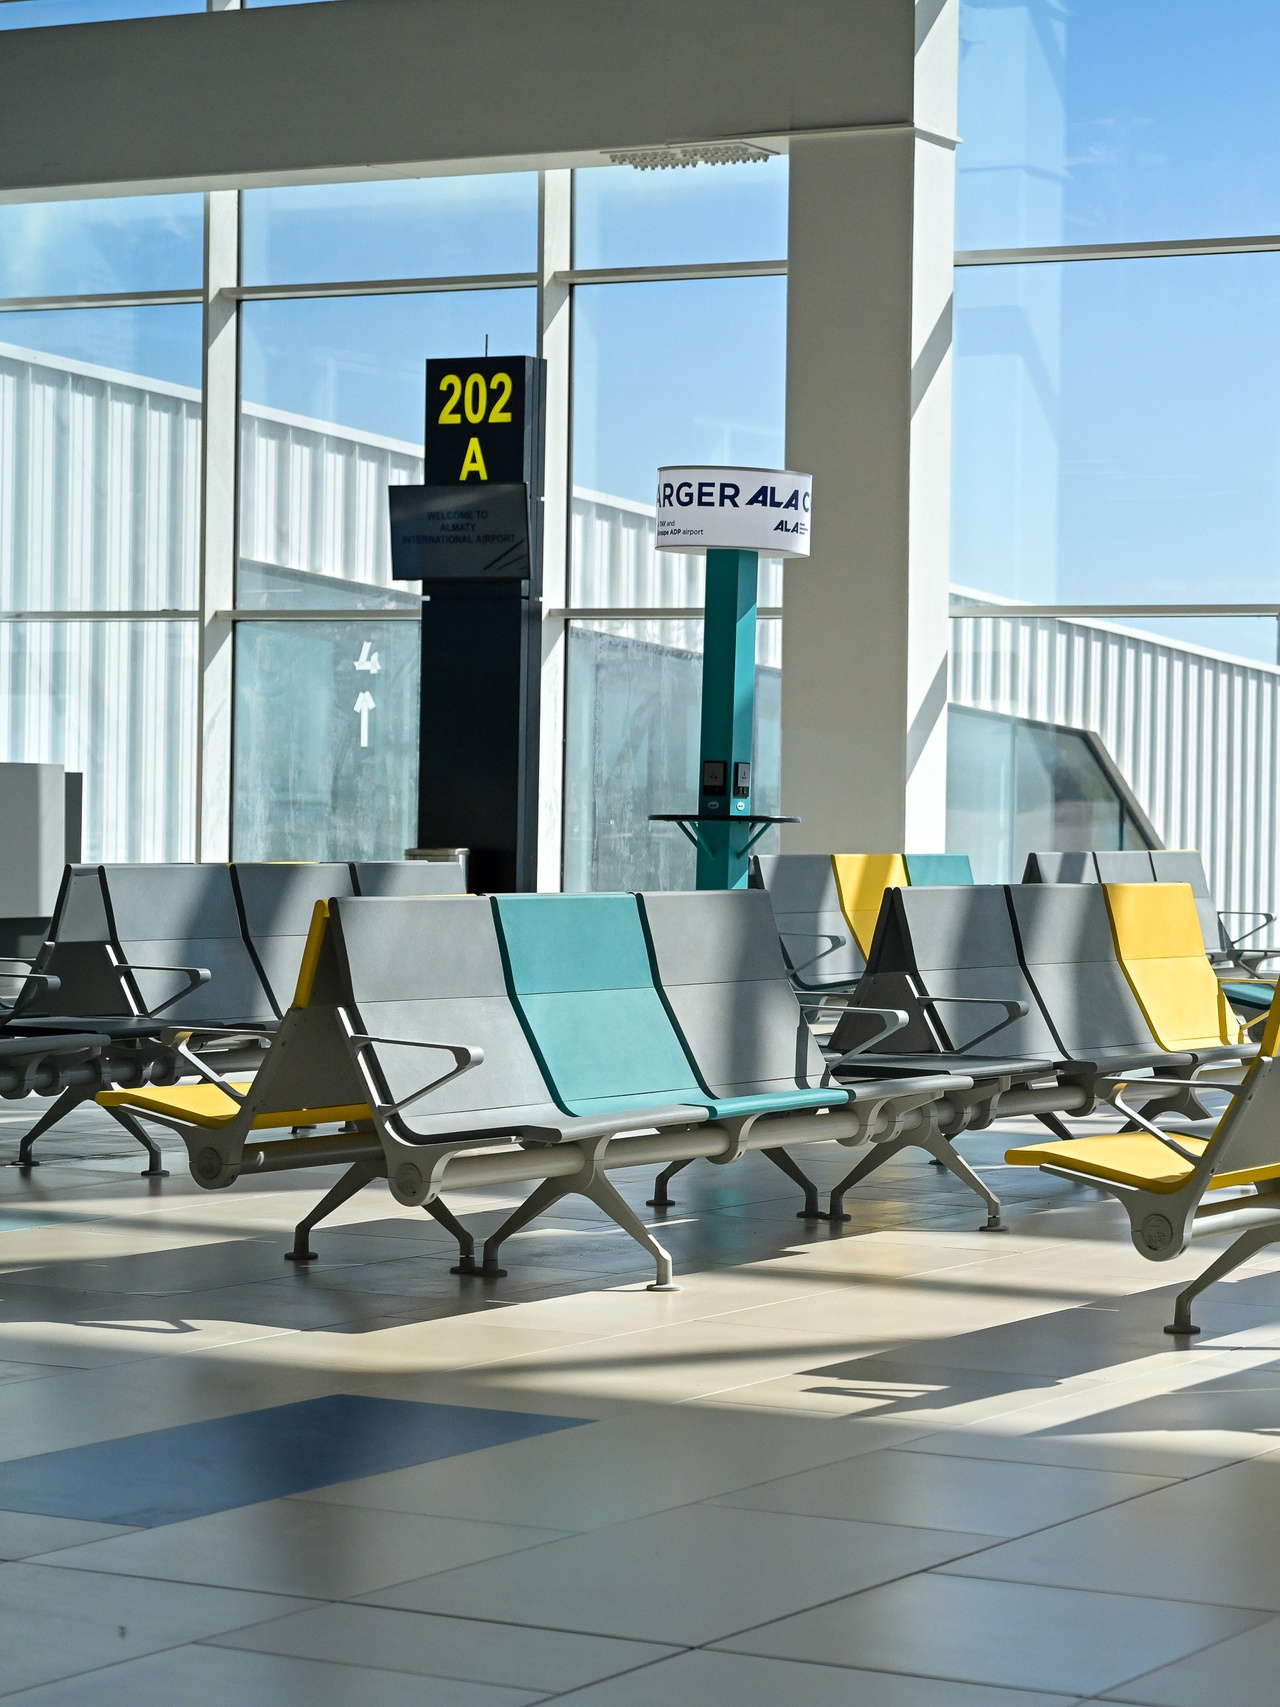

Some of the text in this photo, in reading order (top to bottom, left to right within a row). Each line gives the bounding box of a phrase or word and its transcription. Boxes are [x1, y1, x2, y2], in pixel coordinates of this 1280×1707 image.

[438, 372, 512, 425] 202
[459, 437, 488, 481] A
[745, 486, 799, 510] ALA
[426, 510, 489, 520] WELCOME TO
[439, 523, 476, 532] ALMATY
[682, 528, 704, 536] airport
[773, 520, 799, 533] ALA
[402, 534, 515, 545] INTERNATIONAL AIRPORT
